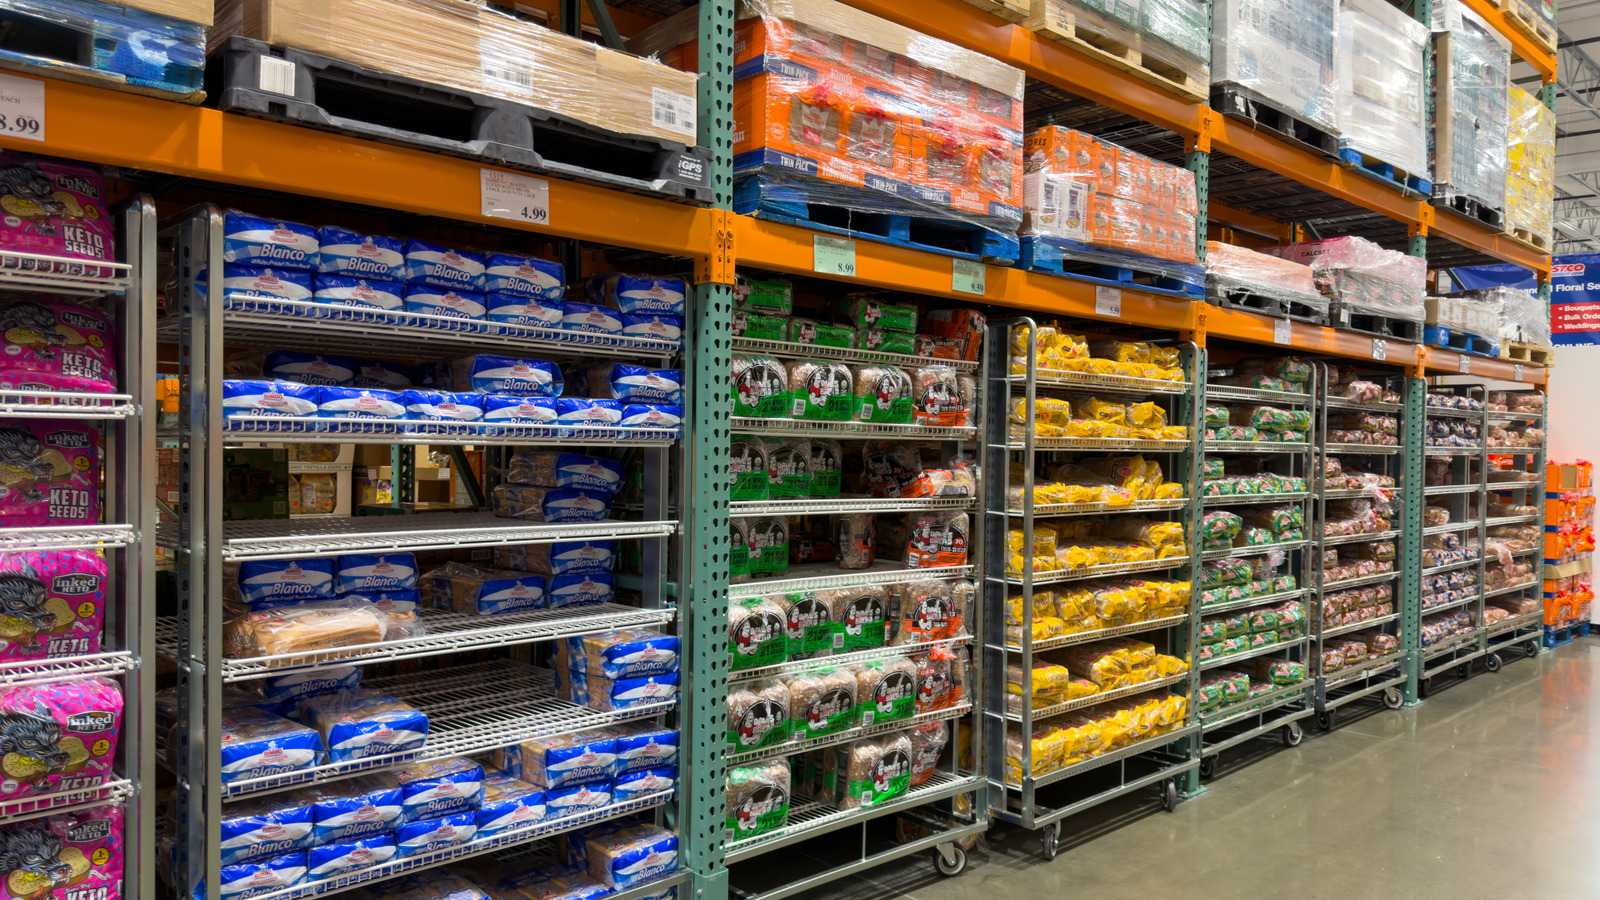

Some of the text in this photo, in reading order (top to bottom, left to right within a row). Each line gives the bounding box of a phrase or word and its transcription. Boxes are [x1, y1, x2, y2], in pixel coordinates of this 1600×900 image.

[781, 64, 809, 80] TWIN PACK
[1, 96, 20, 104] EACH
[1024, 138, 1047, 148] ORES
[781, 156, 808, 172] TWIN PACK
[961, 189, 979, 201] King's
[521, 207, 546, 220] 4.99
[64, 226, 104, 248] KETO
[64, 240, 101, 258] SEEDS
[260, 244, 304, 260] Blanco
[348, 258, 387, 273] Blanco
[838, 263, 853, 273] 8.99
[1552, 264, 1584, 273] STCO
[433, 264, 470, 281] Blanco
[507, 278, 542, 293] Blanco
[971, 283, 983, 292] 9.59
[1556, 283, 1584, 292] Floral
[642, 299, 670, 310] Blanco
[65, 313, 102, 327] inked
[750, 321, 757, 331] 21
[818, 332, 826, 340] 21
[62, 352, 102, 373] KETO
[62, 364, 98, 380] SEEDS
[300, 374, 336, 385] Blanco
[503, 379, 538, 390] Blanco
[637, 386, 666, 397] Blanco
[829, 400, 838, 412] 21
[49, 433, 87, 442] inked
[579, 474, 607, 485] Blanco
[741, 478, 751, 490] 21
[819, 476, 828, 486] 21
[50, 489, 89, 506] KETO
[49, 505, 85, 519] SEEDS
[568, 507, 594, 517] Blanco
[765, 552, 774, 562] 21
[574, 559, 598, 568] Blanco
[56, 577, 96, 587] inked
[364, 576, 398, 587] Blanco
[272, 583, 312, 594] Blanco
[506, 598, 532, 608] Blanco
[572, 593, 598, 602] Blanco
[807, 631, 816, 642] 21
[865, 628, 873, 638] 21
[48, 638, 89, 654] KETO
[760, 647, 770, 657] 21
[634, 661, 662, 671] Blanco
[300, 678, 338, 694] Blanco
[71, 714, 112, 726] inked
[264, 748, 283, 756] BIMBO
[362, 743, 400, 756] Blanco
[634, 756, 662, 767] Blanco
[250, 765, 294, 778] Blanco
[570, 766, 602, 778] Blanco
[59, 777, 102, 791] KETO
[427, 796, 463, 813] Blanco
[566, 805, 597, 816] Blanco
[69, 822, 107, 835] nked
[262, 824, 281, 832] BIMBO
[344, 821, 384, 836] Blanco
[507, 819, 538, 830] Blanco
[248, 839, 293, 857] Blanco
[254, 870, 272, 878] BIMBO
[638, 864, 665, 878] Blanco
[67, 887, 108, 900] KETO
